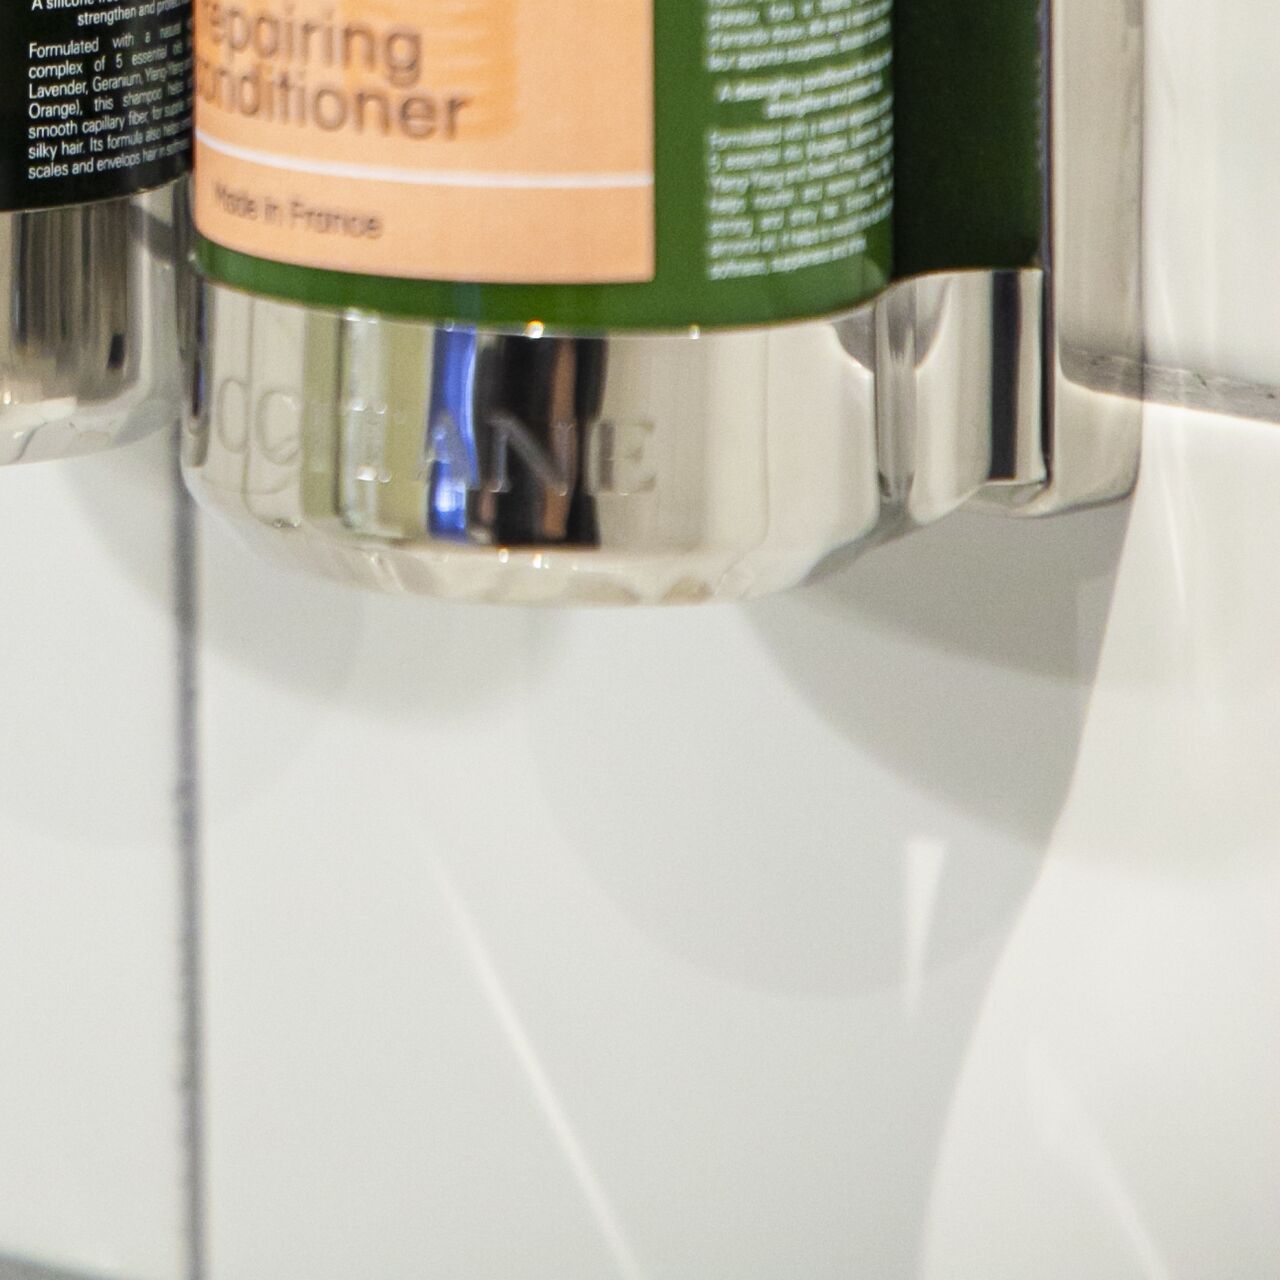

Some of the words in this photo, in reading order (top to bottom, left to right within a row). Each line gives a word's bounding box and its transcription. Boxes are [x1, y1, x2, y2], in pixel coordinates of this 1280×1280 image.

[77, 5, 137, 26] strengthen
[138, 0, 155, 16] and
[29, 36, 99, 59] Formulated
[112, 32, 134, 49] with
[144, 31, 151, 43] a
[201, 0, 420, 88] repairing
[28, 60, 83, 79] complex
[94, 55, 106, 73] of
[116, 53, 123, 69] 5
[29, 81, 88, 99] Lavender,
[196, 57, 471, 140] onditioner
[28, 99, 83, 119] Orange),
[94, 96, 114, 112] this
[28, 121, 78, 139] smooth
[82, 115, 125, 135] capillary
[28, 143, 58, 161] silky
[61, 141, 85, 156] hair.
[90, 137, 103, 152] Its
[107, 131, 144, 150] formula
[28, 162, 69, 180] scales
[71, 157, 94, 174] and
[96, 150, 141, 171] envelops
[289, 198, 383, 240] France
